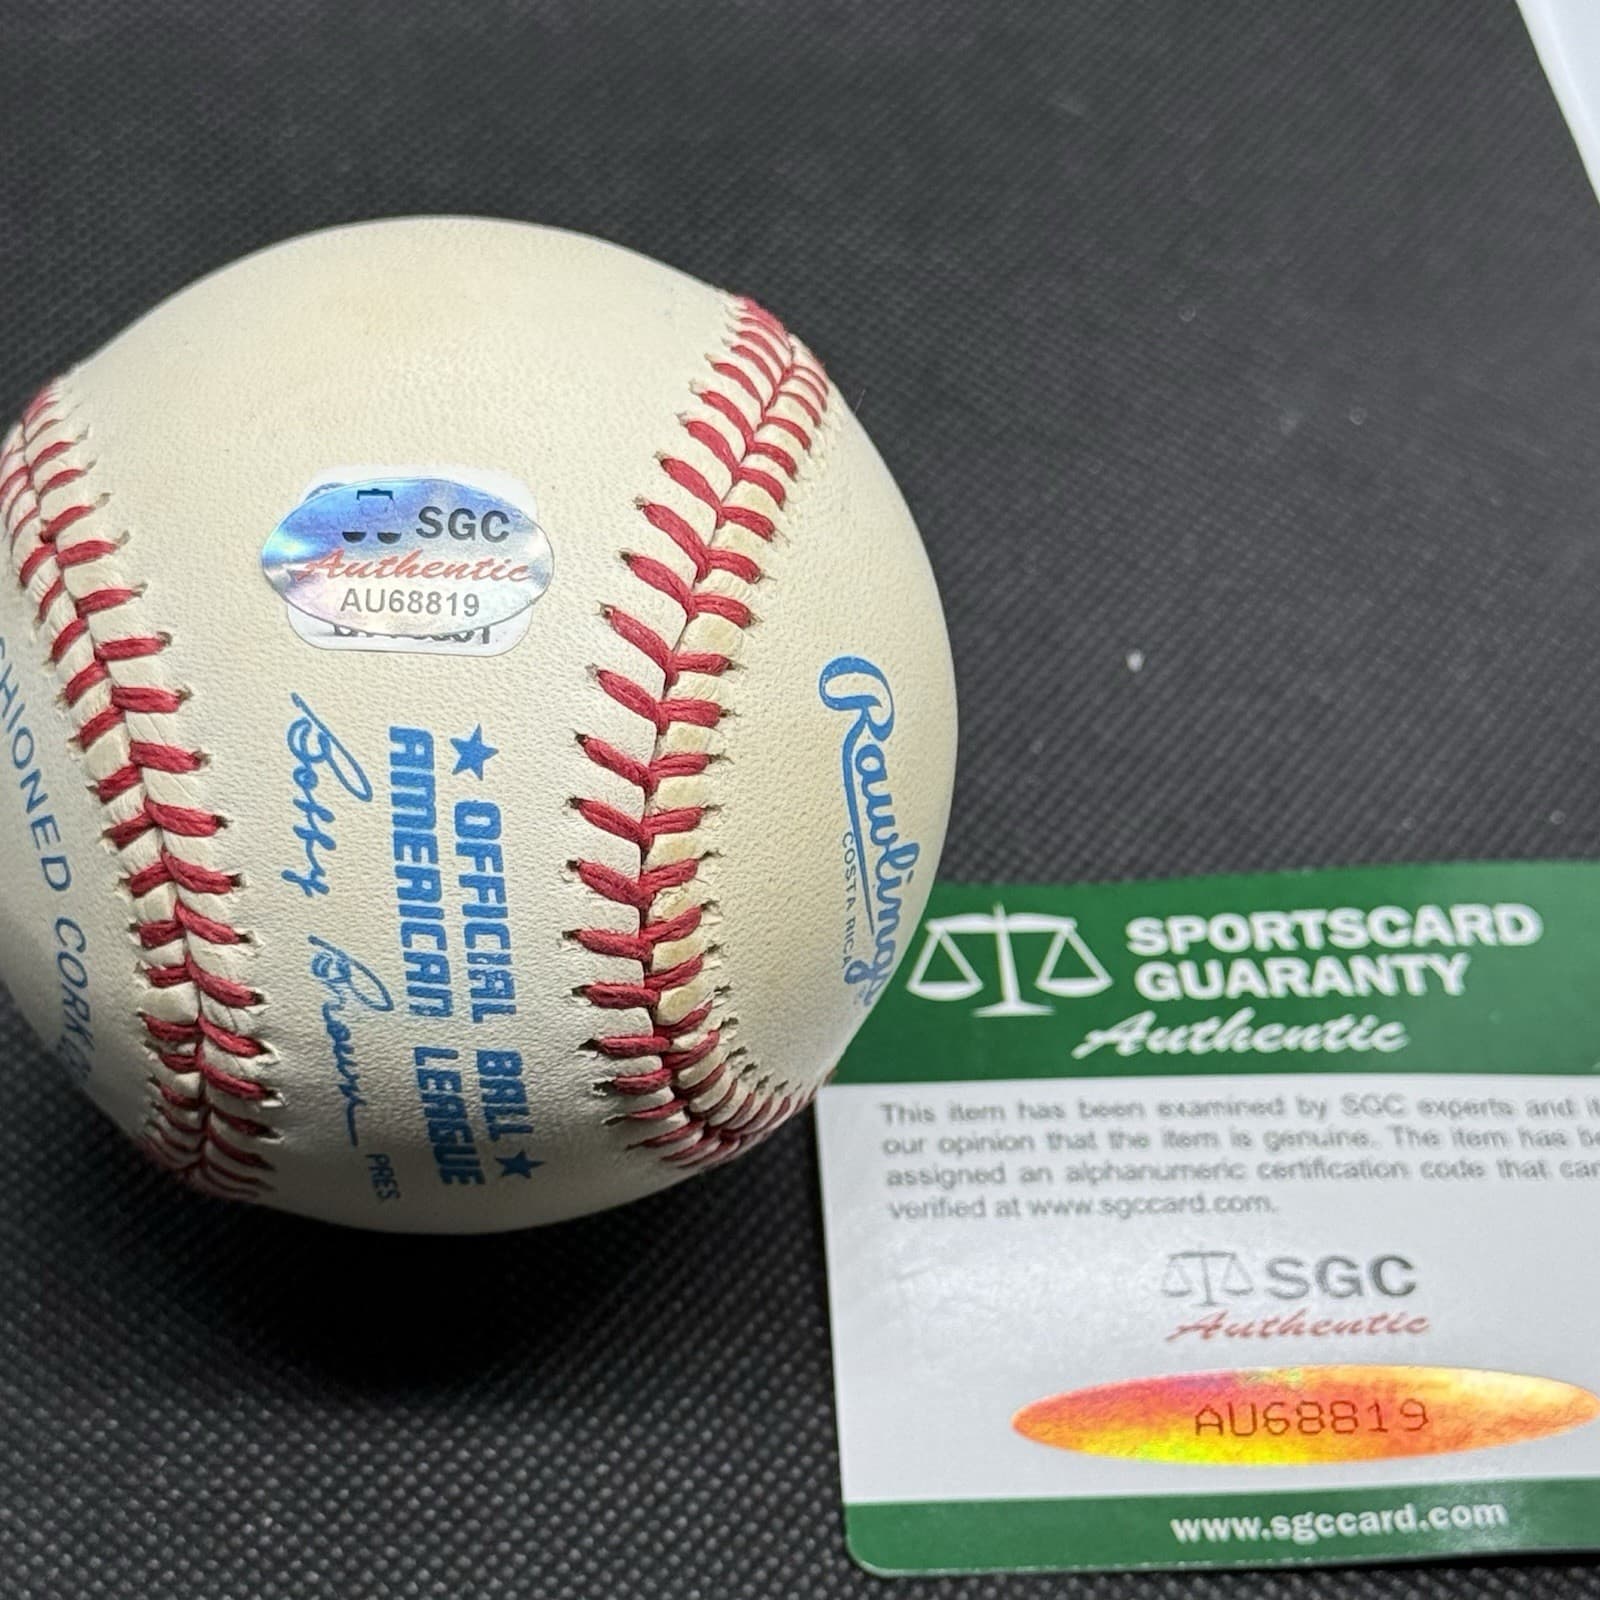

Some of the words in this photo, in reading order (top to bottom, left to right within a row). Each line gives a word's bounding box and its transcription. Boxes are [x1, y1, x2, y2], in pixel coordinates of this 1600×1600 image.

[416, 506, 510, 543] SGC
[294, 549, 530, 583] Authentic
[340, 588, 480, 617] AU68819
[0, 636, 72, 892] HIONED
[818, 655, 920, 1007] Rawlings
[388, 724, 454, 1020] AMERICAN
[841, 830, 856, 912] COSTA
[454, 798, 518, 1025] OFFICIAL
[1126, 903, 1543, 956] SPORTSCARD
[1134, 953, 1470, 1001] GUARANTY
[1072, 1008, 1410, 1059] Authentic
[413, 1046, 486, 1187] LEAGUE
[476, 1048, 534, 1144] BALL
[881, 1101, 936, 1124] This
[950, 1100, 1005, 1122] item
[1018, 1098, 1065, 1120] has
[1078, 1097, 1145, 1119] been
[1158, 1094, 1285, 1118] examined
[1297, 1094, 1327, 1122] by
[1340, 1092, 1405, 1117] SGC
[1417, 1096, 1513, 1120] experts
[1526, 1097, 1574, 1117] and
[883, 1134, 924, 1155] our
[938, 1131, 1034, 1157] opinion
[1047, 1128, 1097, 1150] that
[1109, 1128, 1149, 1150] the
[1163, 1128, 1220, 1149] item
[1230, 1126, 1252, 1147] is
[1263, 1127, 1379, 1153] genuine.
[1389, 1124, 1441, 1147] The
[1452, 1126, 1507, 1147] item
[1518, 1126, 1568, 1148] has
[365, 1153, 400, 1202] PRES
[886, 1162, 1005, 1190] assigned
[1020, 1164, 1053, 1184] an
[1066, 1159, 1246, 1186] alphanumeric
[1257, 1158, 1406, 1180] certification
[1420, 1158, 1485, 1180] code
[1497, 1158, 1547, 1179] that
[890, 1194, 986, 1219] verified
[996, 1195, 1021, 1217] at
[1030, 1192, 1278, 1220] www.sgccard.com.
[1266, 1255, 1417, 1299] SGC
[1165, 1308, 1430, 1342] Authentic
[1195, 1400, 1430, 1438] AU68819
[1170, 1504, 1508, 1544] www.sgccard.com
